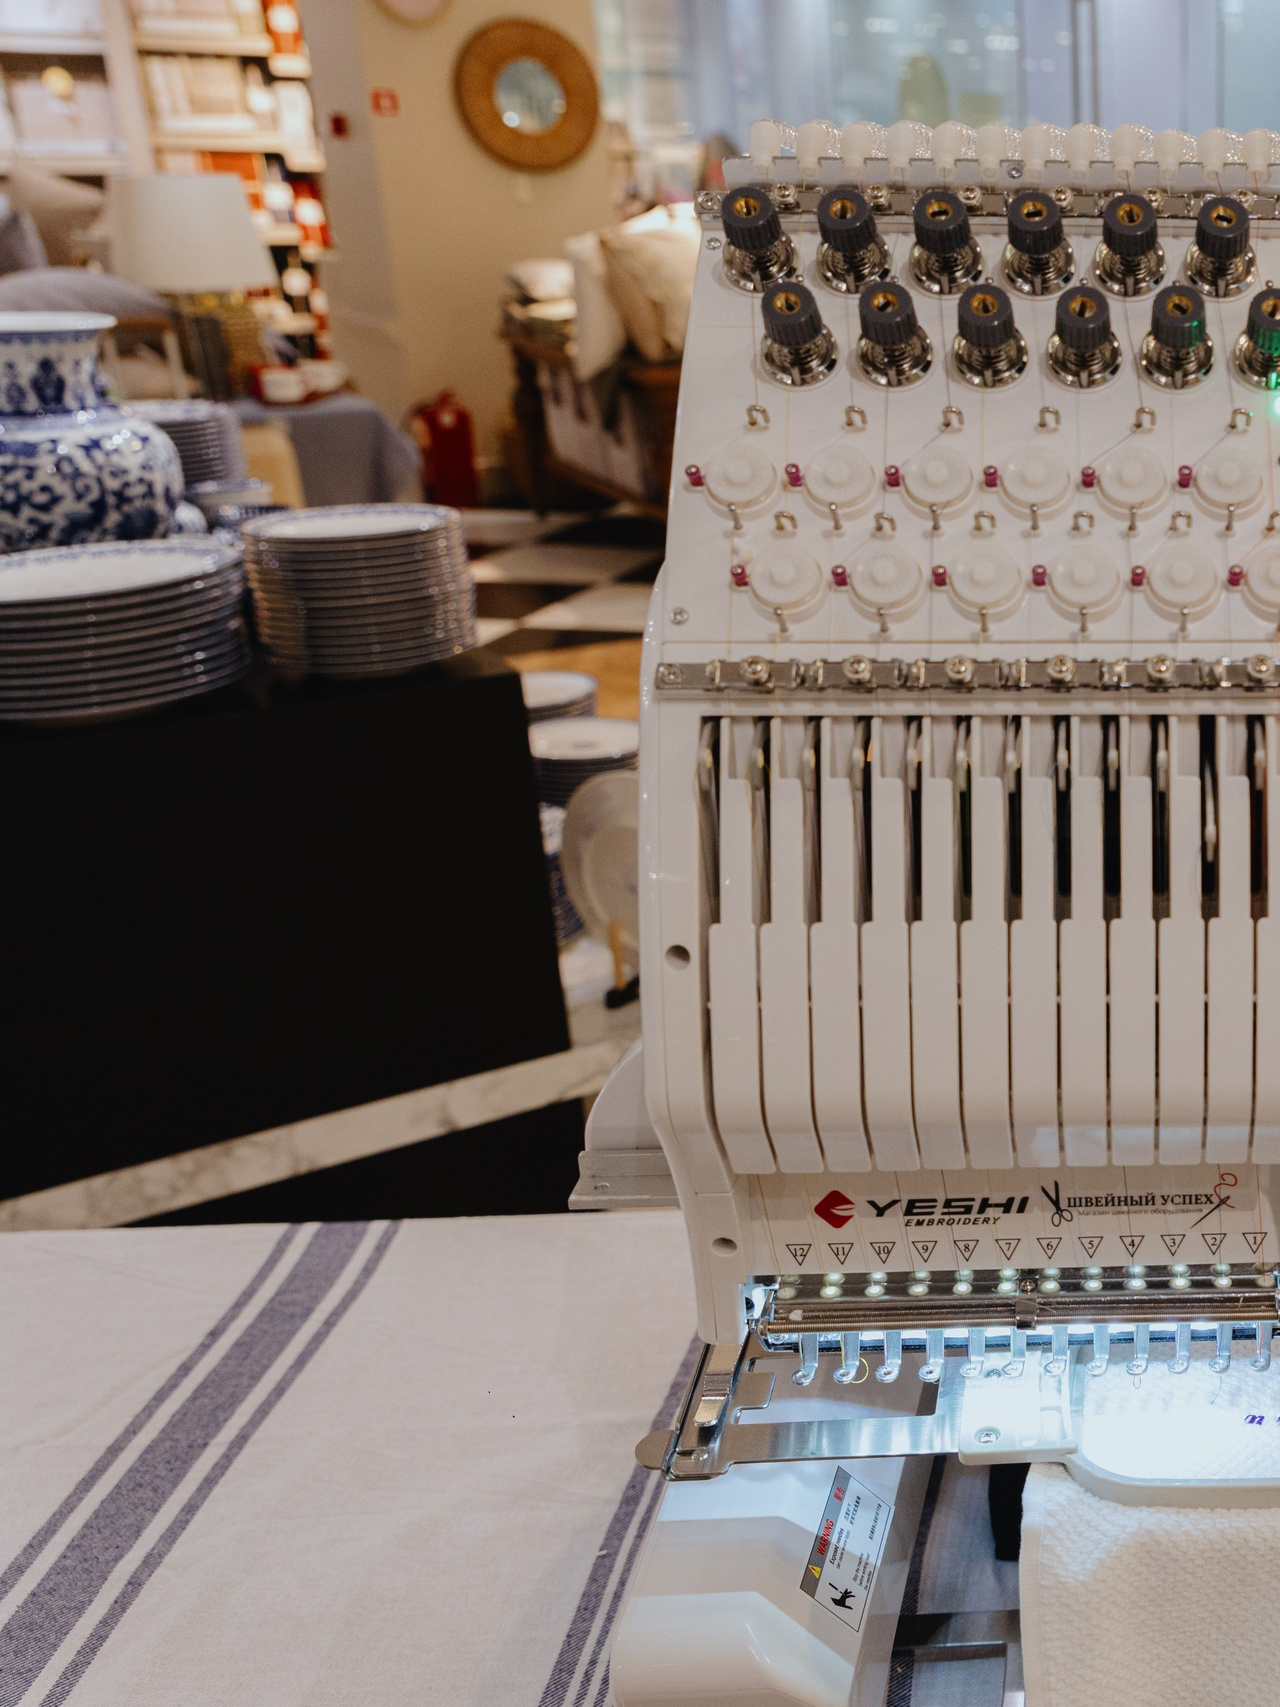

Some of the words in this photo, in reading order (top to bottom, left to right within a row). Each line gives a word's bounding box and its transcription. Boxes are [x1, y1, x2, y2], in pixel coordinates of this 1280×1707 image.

[1067, 1193, 1156, 1208] ШВЕЙНЫЙ
[1160, 1194, 1214, 1206] УСПЕХ
[866, 1196, 1029, 1218] YESHI
[1150, 1208, 1203, 1216] оборудования
[905, 1217, 1000, 1227] EMBROIDERY
[1087, 1240, 1094, 1249] 5
[1128, 1239, 1135, 1248] 4
[1170, 1238, 1176, 1247] 3
[1211, 1237, 1218, 1246] 2
[1252, 1236, 1257, 1245] 1
[877, 1245, 889, 1255] 10
[921, 1244, 928, 1253] 9
[963, 1244, 970, 1252] 8
[1005, 1242, 1011, 1251] 7
[1046, 1241, 1053, 1250] 6
[794, 1248, 806, 1256] 12
[836, 1247, 845, 1255] 11
[818, 1519, 834, 1556] WARNING
[829, 1544, 839, 1565] Exposed
[836, 1528, 844, 1545] needles
